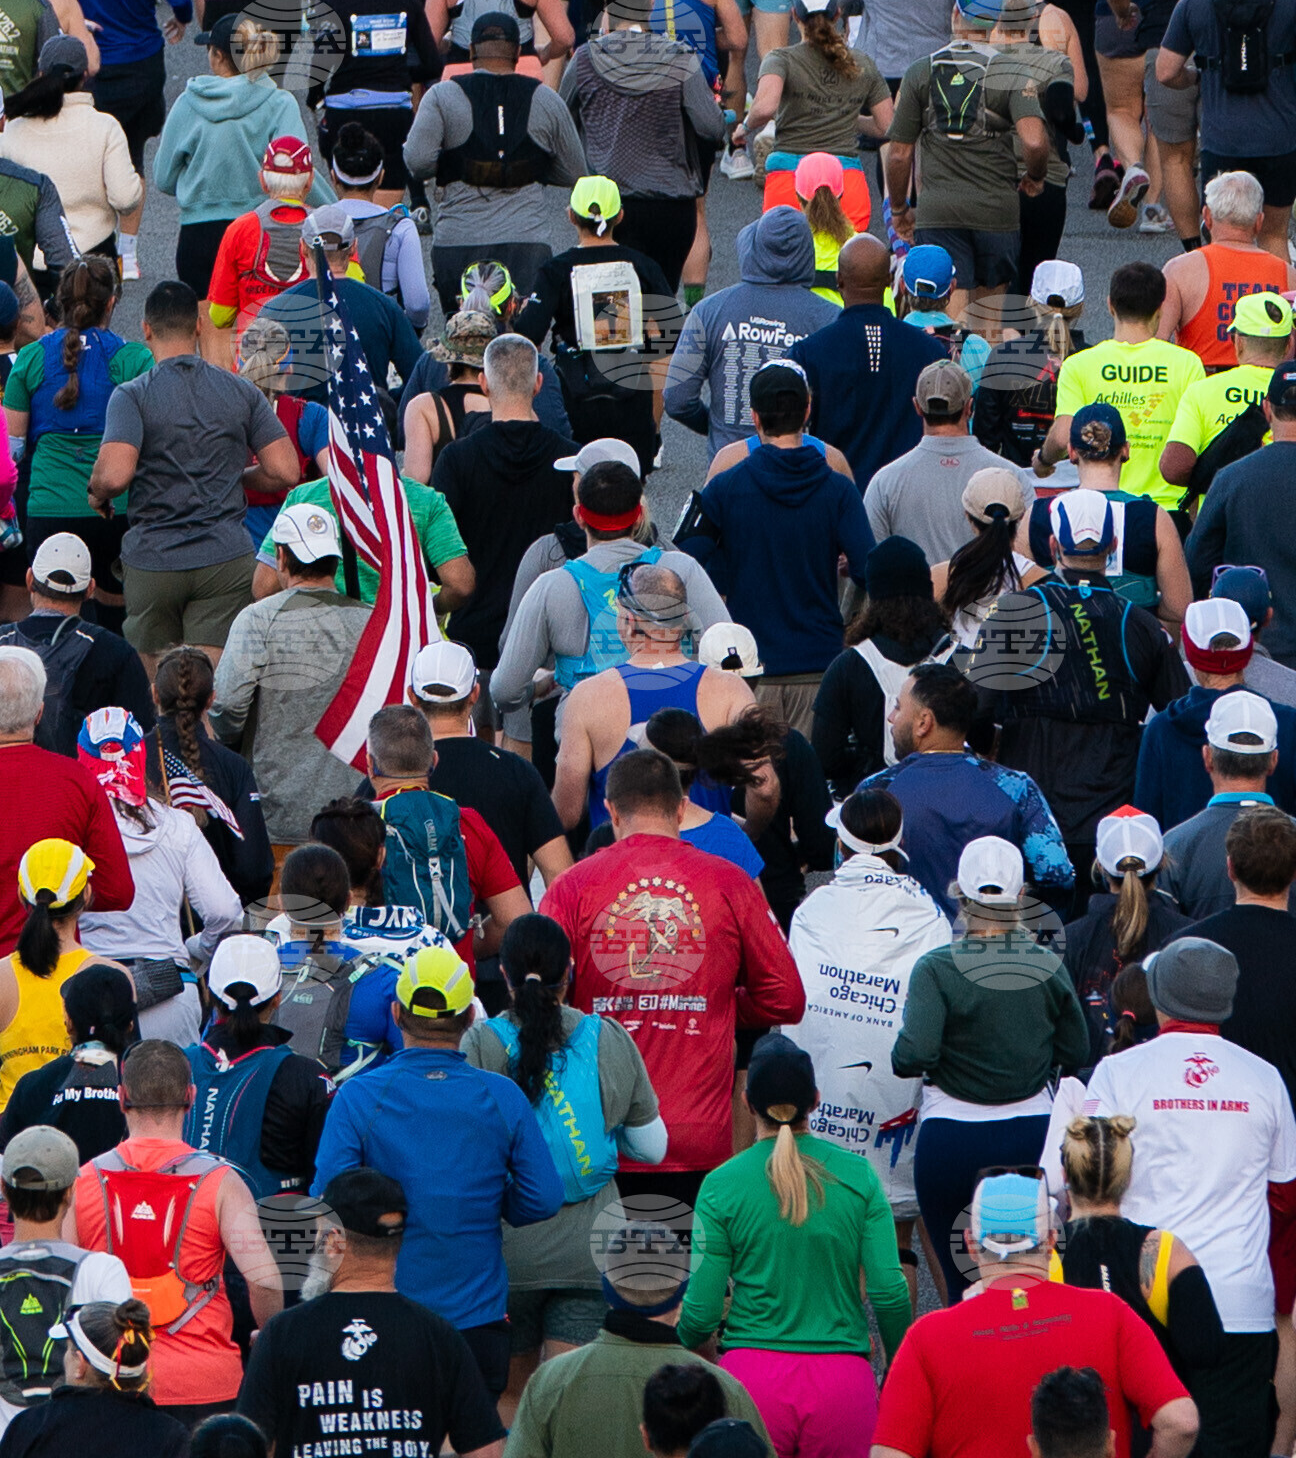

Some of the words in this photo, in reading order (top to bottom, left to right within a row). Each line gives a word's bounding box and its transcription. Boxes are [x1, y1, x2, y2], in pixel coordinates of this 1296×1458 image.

[1102, 364, 1168, 383] GUIDE
[1095, 391, 1146, 406] Achilles
[1069, 603, 1110, 700] NATHAN
[368, 905, 418, 928] NYC
[830, 986, 896, 1014] Chicago
[807, 1003, 849, 1020] AMERICA
[850, 1014, 863, 1023] OF
[870, 1017, 894, 1028] BANK
[40, 1046, 60, 1056] PARK
[64, 1088, 81, 1102] My
[83, 1086, 121, 1101] Brothe
[817, 1102, 875, 1125] Marath
[1153, 1098, 1205, 1111] BROTHERS
[1207, 1099, 1218, 1112] IN
[1220, 1099, 1250, 1114] ARMS
[199, 1087, 218, 1150] NATHA
[543, 1069, 593, 1176] NATHAN
[810, 1116, 870, 1143] Chicago
[297, 1379, 354, 1408] PAIN
[362, 1388, 384, 1409] IS
[319, 1409, 423, 1434] WEAKNESS
[293, 1438, 363, 1458] LEAVING
[365, 1436, 388, 1450] THE
